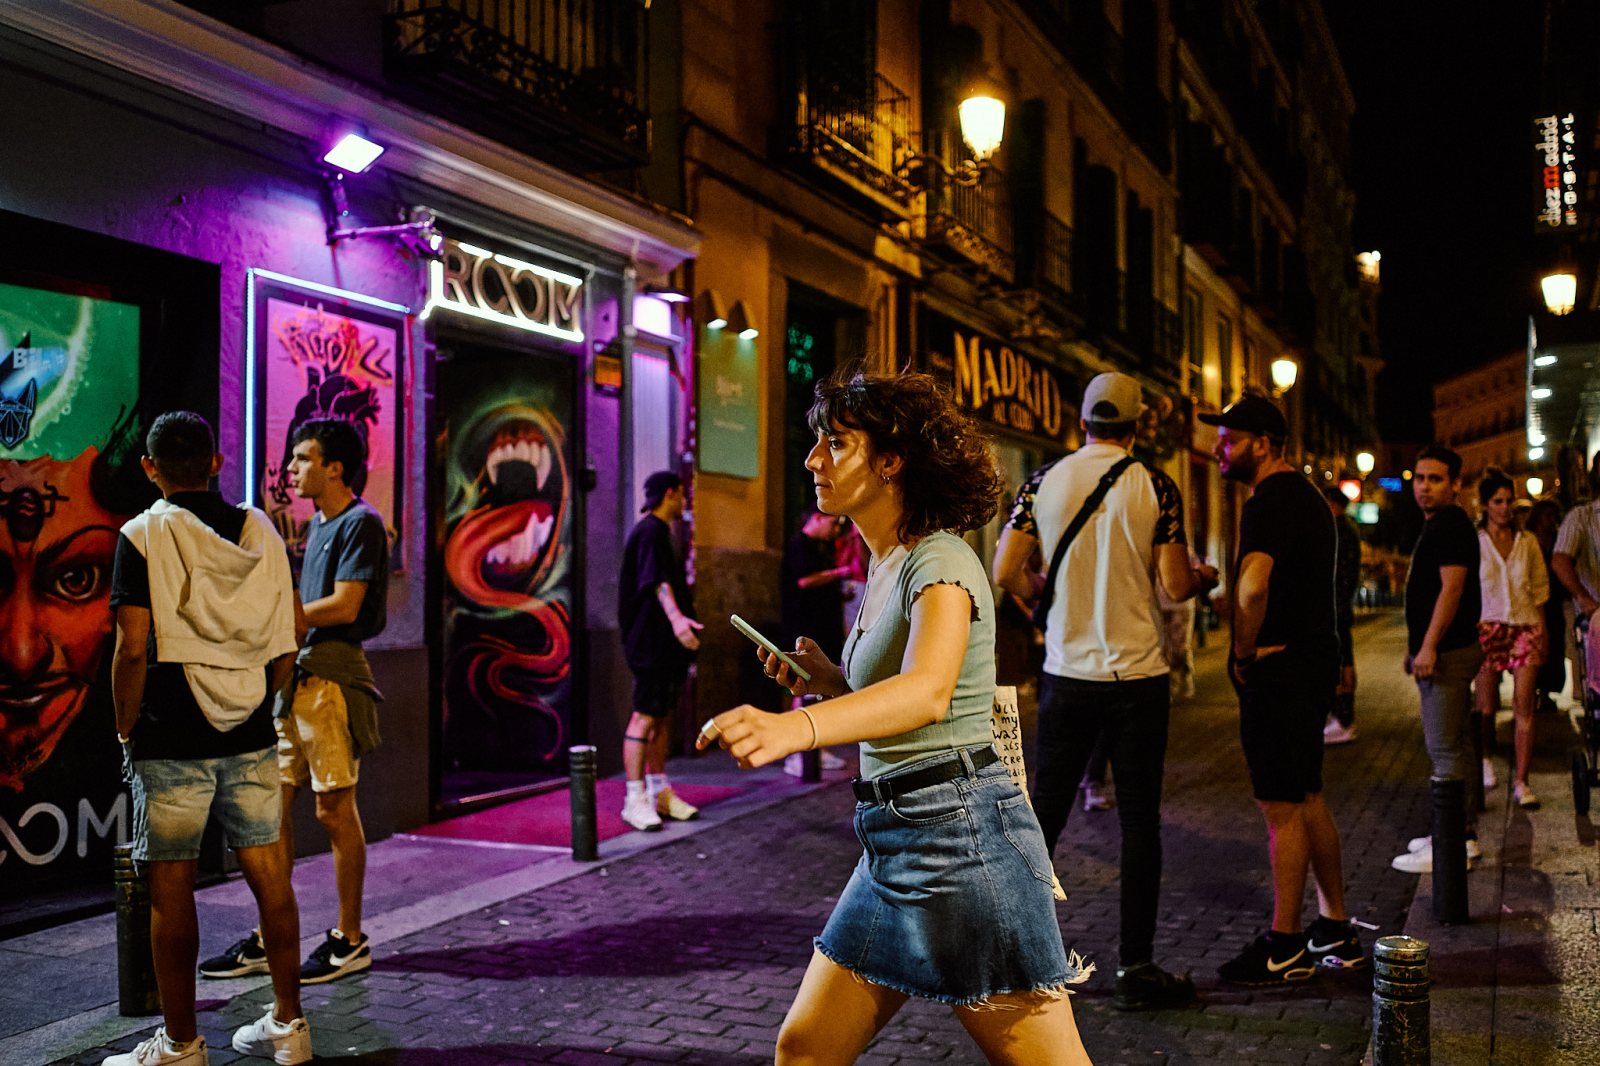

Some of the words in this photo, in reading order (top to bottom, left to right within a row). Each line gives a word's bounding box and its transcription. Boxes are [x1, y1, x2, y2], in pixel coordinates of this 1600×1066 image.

[442, 238, 583, 336] ROOM
[954, 330, 1061, 437] MADRID
[0, 792, 128, 866] OM
